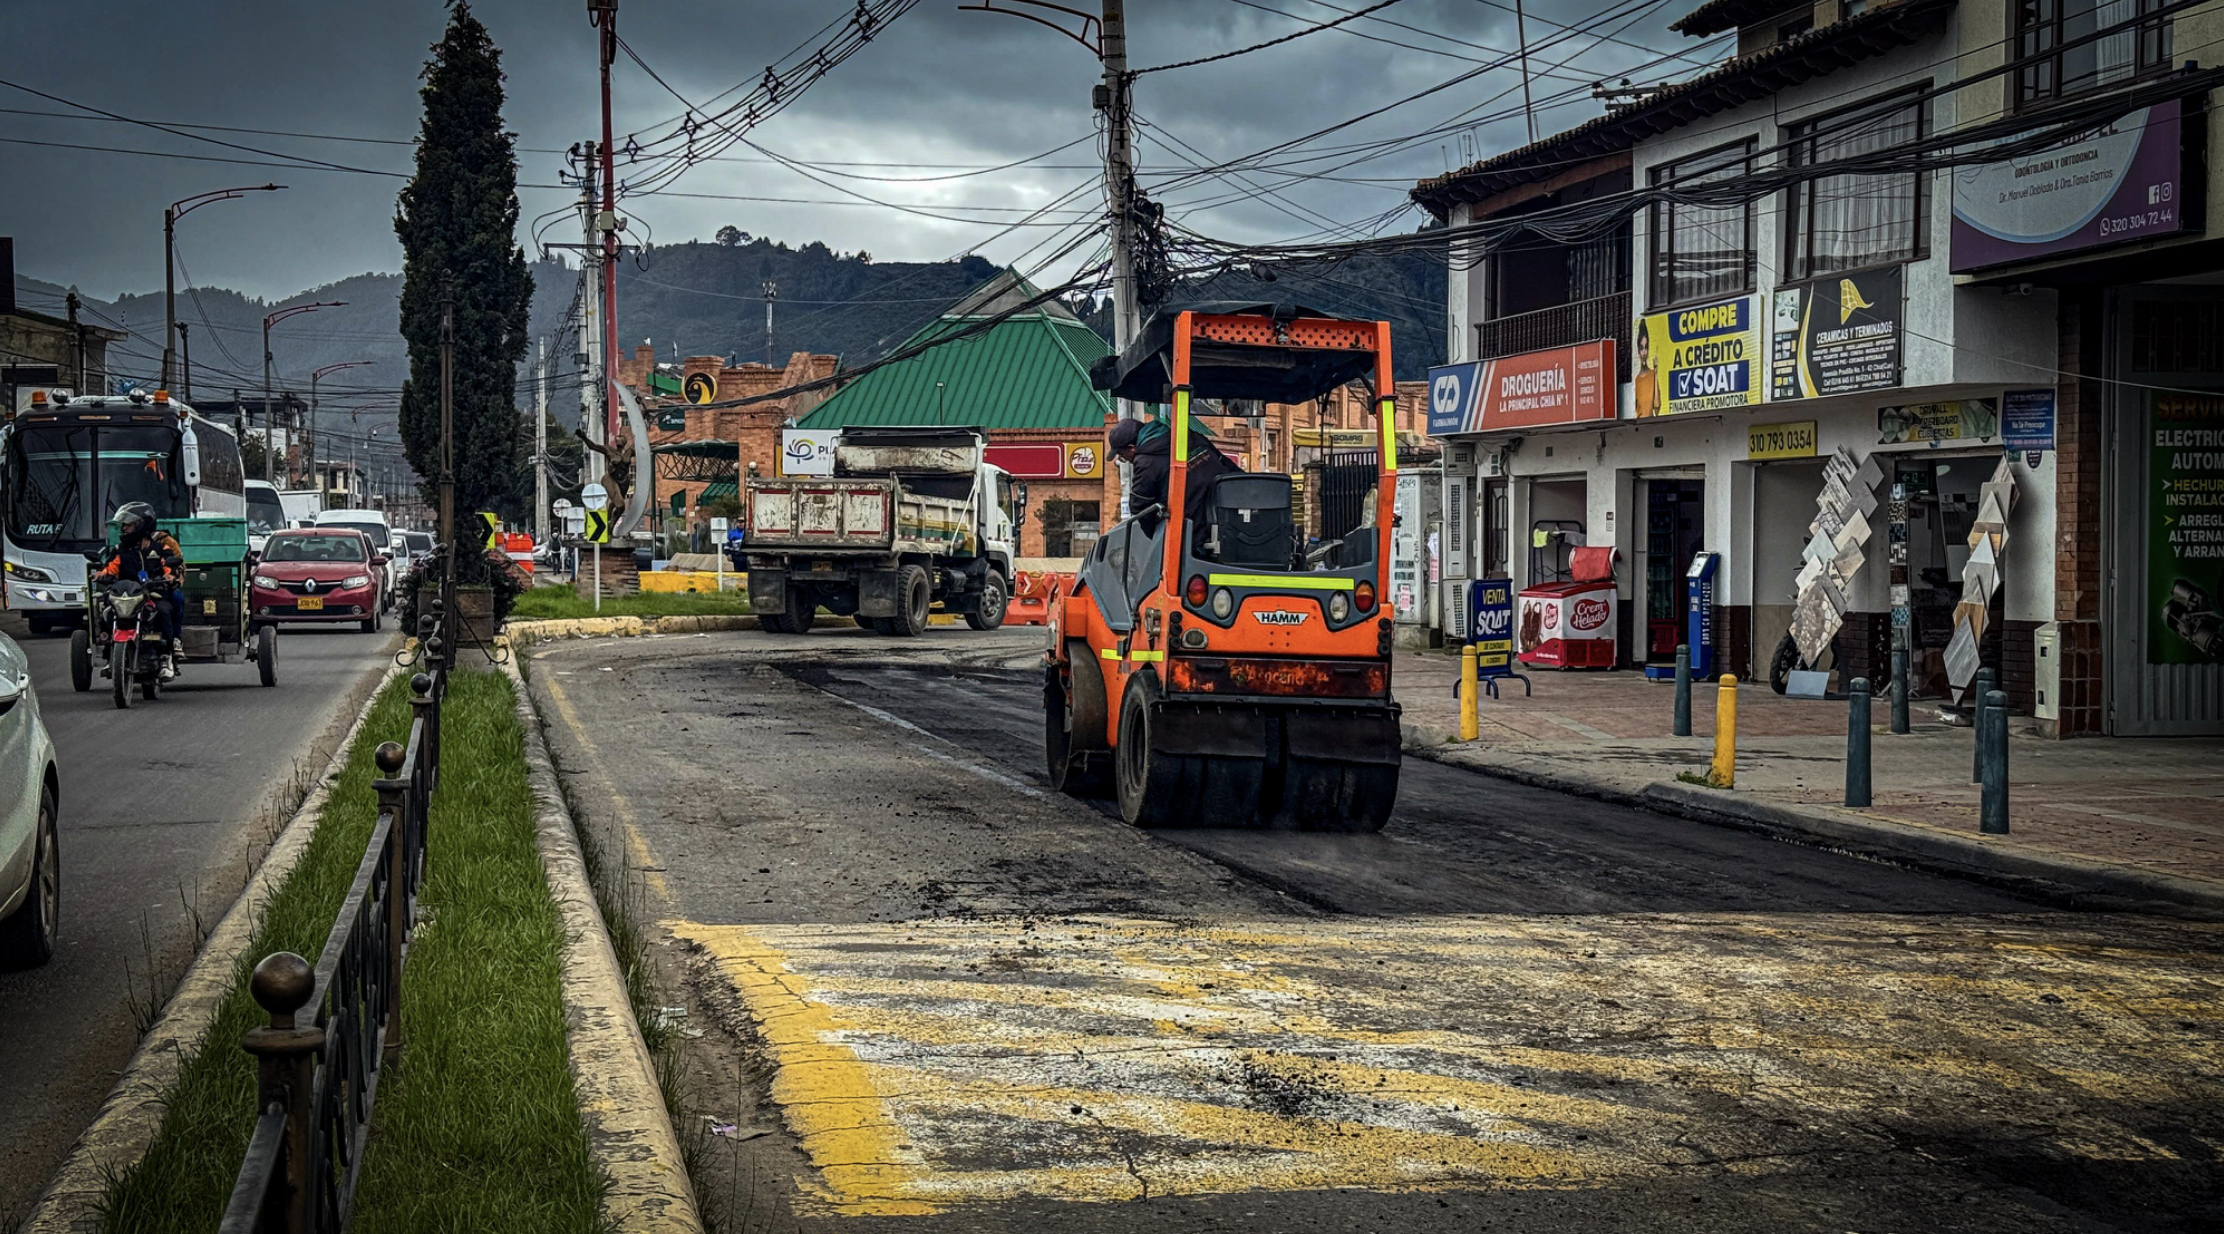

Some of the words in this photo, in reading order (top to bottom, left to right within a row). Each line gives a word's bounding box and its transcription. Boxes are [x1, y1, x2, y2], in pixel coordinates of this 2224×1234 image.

[2054, 159, 2060, 170] Y
[2060, 149, 2098, 168] ORTODONCIA
[2054, 180, 2059, 190] &
[2090, 169, 2113, 183] Barrios
[2111, 216, 2128, 233] 320
[2129, 214, 2146, 230] 304
[2148, 211, 2158, 226] 72
[2160, 209, 2172, 224] 44
[1678, 303, 1737, 336] COMPRE
[1816, 328, 1848, 344] CERAMICAS
[1849, 328, 1854, 338] Y
[1855, 320, 1893, 338] TERMINADOS
[1673, 348, 1682, 368] A
[1685, 338, 1744, 366] CRÉDITO
[1501, 363, 1566, 398] DROGUERÍA
[1693, 364, 1738, 396] SOAT
[1500, 400, 1507, 412] LA
[1508, 397, 1539, 412] PRINCIPAL
[1669, 399, 1705, 413] FINANCIERA
[1706, 394, 1748, 409] PROMOTORA
[1750, 433, 1764, 453] 310
[1767, 432, 1784, 452] 793
[1787, 430, 1812, 450] 0354
[2174, 478, 2224, 492] HECHUR
[26, 524, 54, 534] RUTA
[2178, 514, 2224, 527] ARREGL
[2172, 545, 2182, 558] Y
[2183, 545, 2224, 558] ARRAN
[1482, 588, 1506, 606] VENTA
[1577, 602, 1604, 614] Crem
[1261, 613, 1300, 624] HAMM
[1477, 610, 1510, 636] SOAT
[1574, 612, 1606, 628] Helado
